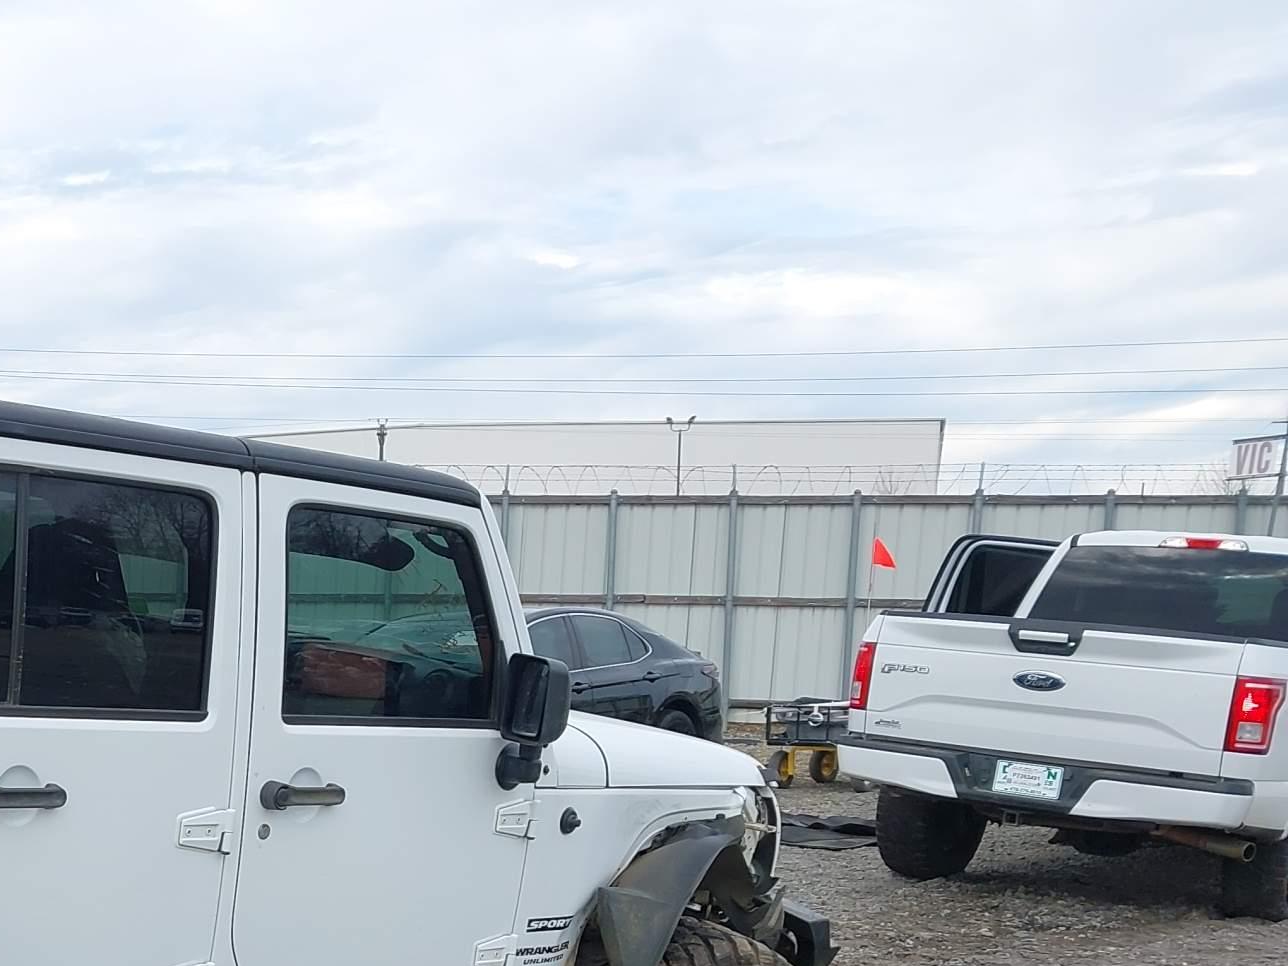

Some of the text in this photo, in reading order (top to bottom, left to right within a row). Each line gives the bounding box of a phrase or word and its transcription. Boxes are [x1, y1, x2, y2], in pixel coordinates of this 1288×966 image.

[1236, 441, 1273, 476] VIC
[1022, 673, 1057, 689] Ford
[528, 918, 572, 930] SPORT
[515, 940, 570, 957] WRANGLER
[522, 953, 564, 965] UNLIMITED
